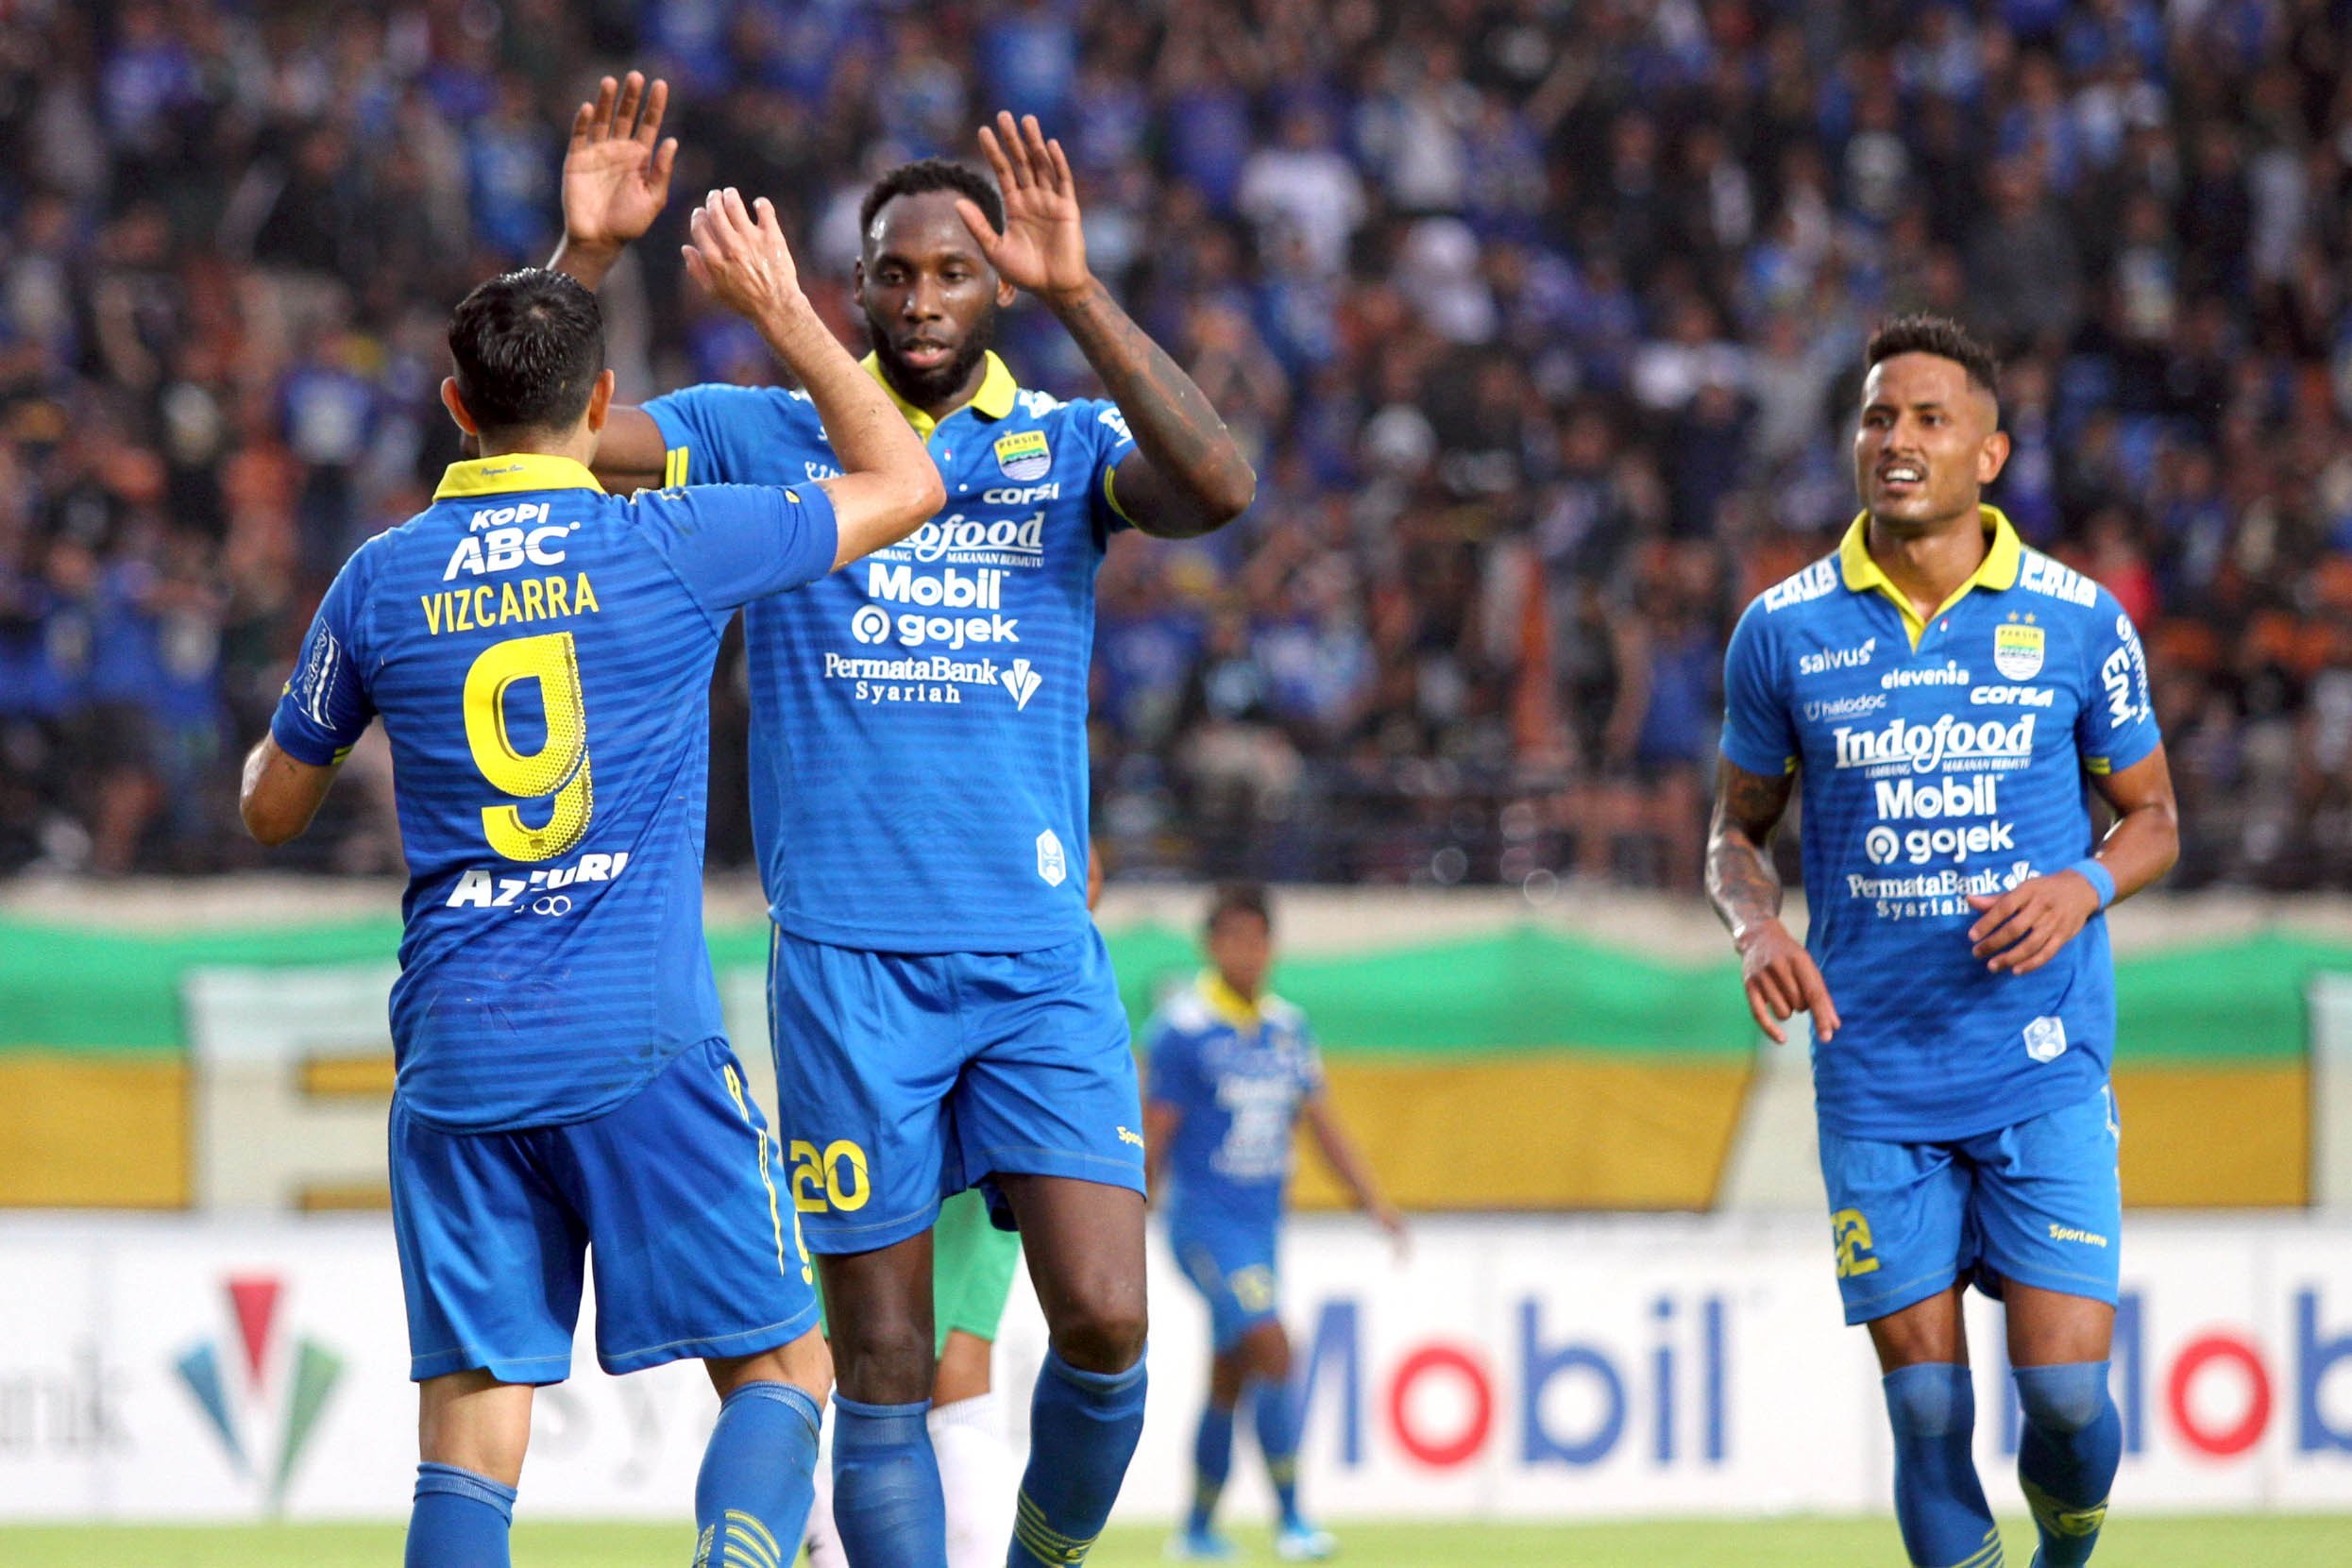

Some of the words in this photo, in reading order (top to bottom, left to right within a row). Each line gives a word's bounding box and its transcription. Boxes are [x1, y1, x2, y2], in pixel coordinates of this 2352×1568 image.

[469, 502, 550, 532] KOPI
[443, 526, 570, 582] ABC
[904, 514, 1045, 563] ofood
[946, 551, 998, 565] MAKANAN
[421, 571, 600, 635] VIZCARRA
[869, 563, 1001, 610] Mobil
[897, 614, 1020, 649] gojek
[824, 652, 999, 685] PermataBank
[1800, 642, 1873, 675] salvus
[1881, 660, 1970, 689] elevenia
[855, 681, 961, 704] Syariah
[1821, 694, 1887, 717] halodoc
[463, 631, 594, 863] 9
[1833, 713, 2036, 774] Indofood
[1874, 774, 1997, 820] Mobil
[1904, 819, 2015, 864] gojek
[1847, 868, 2001, 899] PermataBank
[1876, 898, 1970, 921] Syariah
[789, 1138, 871, 1213] 20
